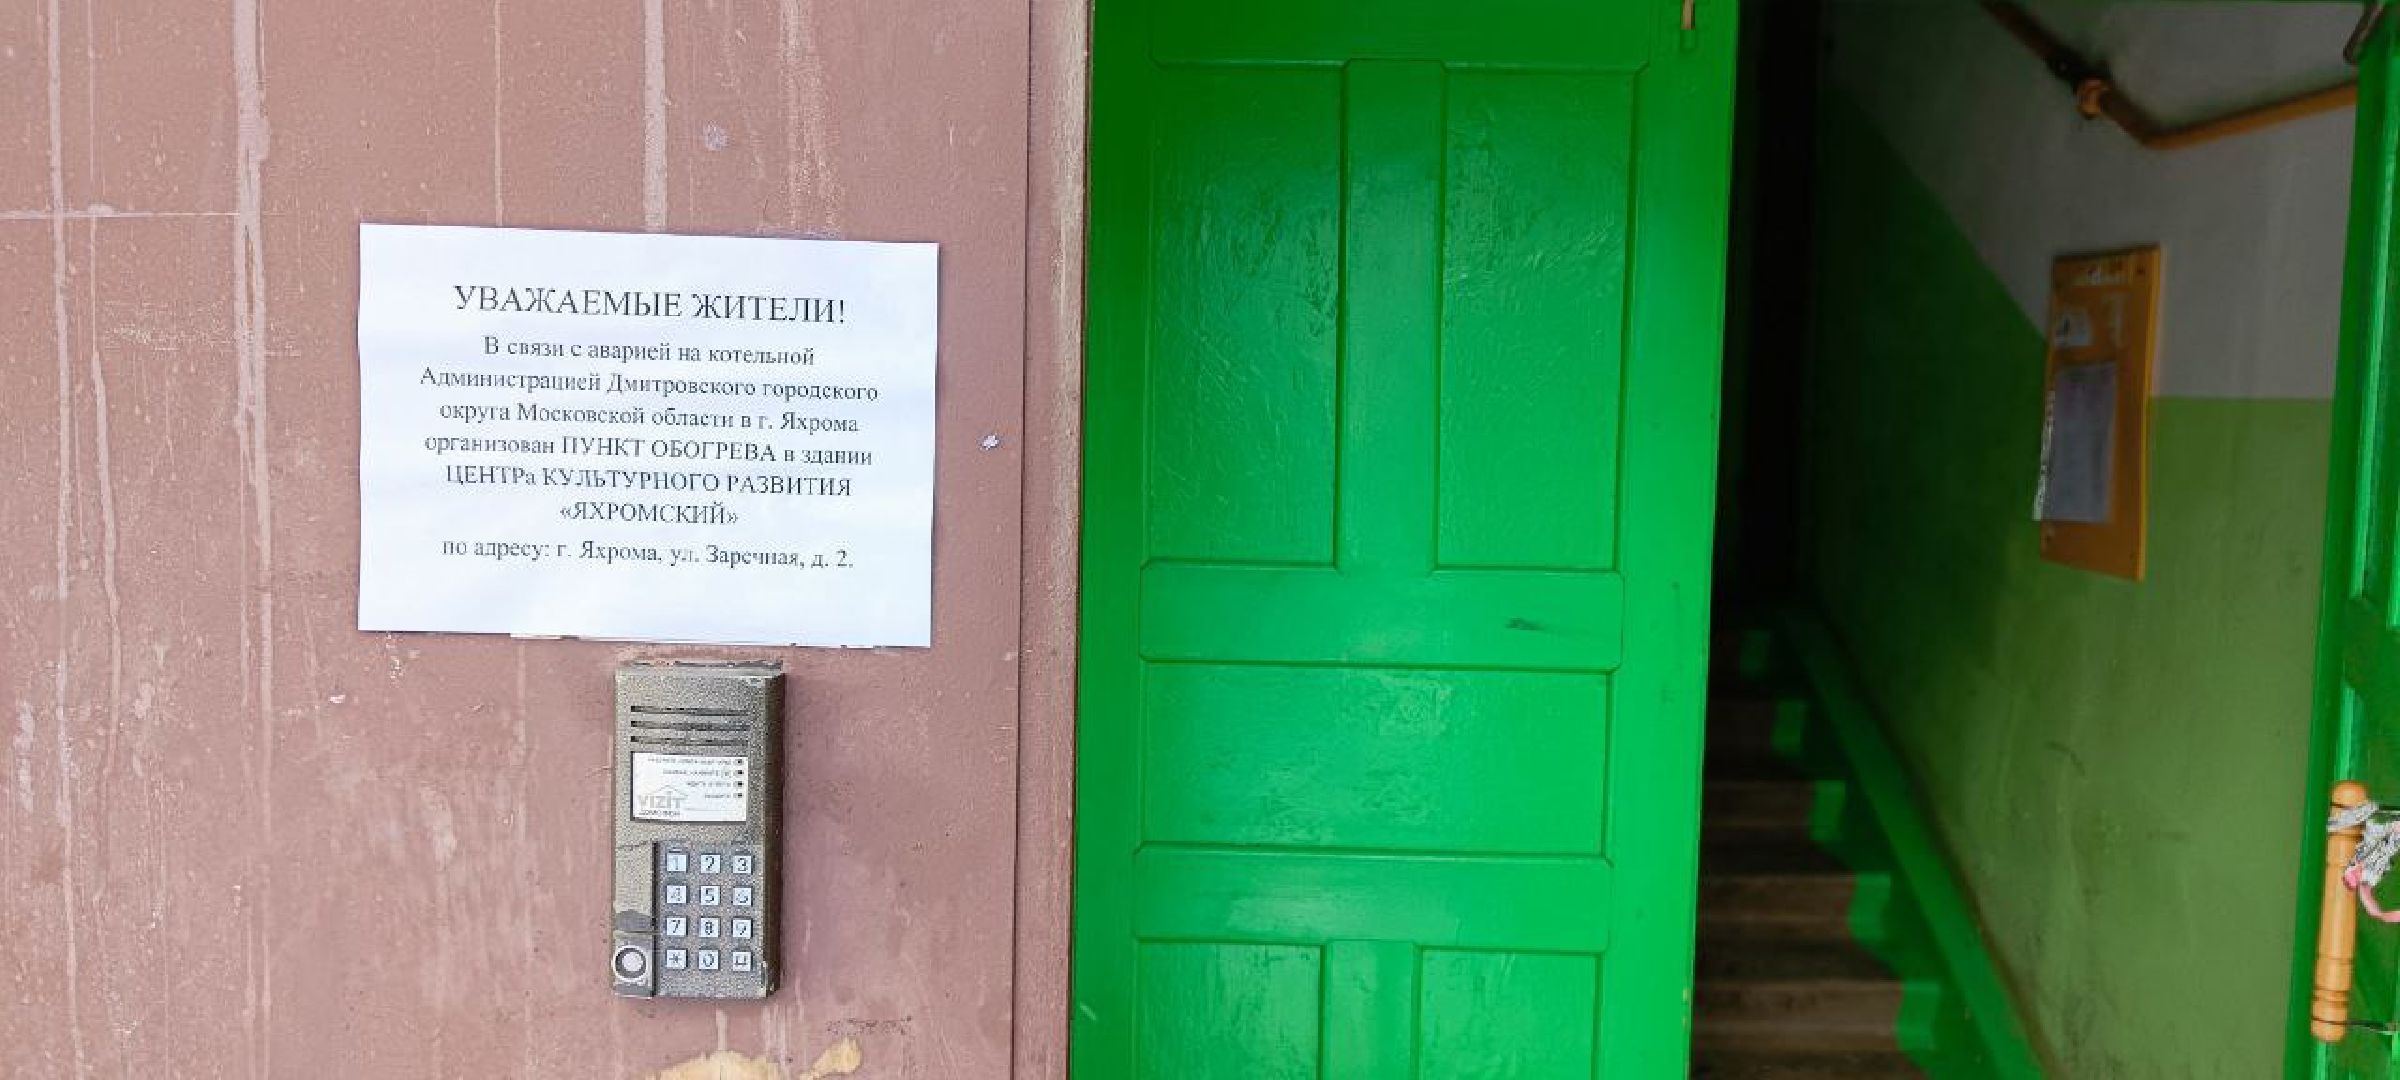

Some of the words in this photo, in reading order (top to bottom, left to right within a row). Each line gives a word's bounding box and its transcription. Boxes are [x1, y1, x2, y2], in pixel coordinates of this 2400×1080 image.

[454, 285, 682, 317] УВАЖАЕМЫЕ
[691, 293, 845, 324] ЖИТЕЛИ!
[484, 335, 499, 354] В
[507, 342, 564, 357] связи
[570, 344, 583, 357] с
[587, 341, 671, 363] аварией
[678, 347, 701, 361] на
[708, 347, 814, 366] котельной
[420, 366, 600, 393] Администрацией
[606, 372, 756, 398] Дмитровского
[763, 383, 879, 402] городского
[439, 404, 511, 423] округа
[516, 402, 644, 425] Московской
[651, 407, 734, 428] области
[740, 415, 752, 428] в
[759, 415, 773, 429] г.
[780, 411, 859, 435] Яхрома
[424, 436, 555, 456] организован
[562, 435, 646, 457] ПУНКТ
[651, 439, 777, 462] ОБОГРЕВА
[784, 449, 796, 463] в
[800, 449, 872, 465] здании
[446, 465, 536, 485] ЦЕНТРа
[542, 467, 721, 491] КУЛЬТУРНОГО
[727, 474, 852, 496] РАЗВИТИЯ
[560, 501, 739, 524] «ЯХРОМСКИЙ»
[442, 540, 468, 556] по
[474, 542, 550, 561] адресу:
[557, 544, 572, 557] г.
[669, 549, 700, 567] ул.
[706, 544, 805, 569] Заречная,
[810, 554, 829, 568] д.
[836, 549, 854, 568] 2.
